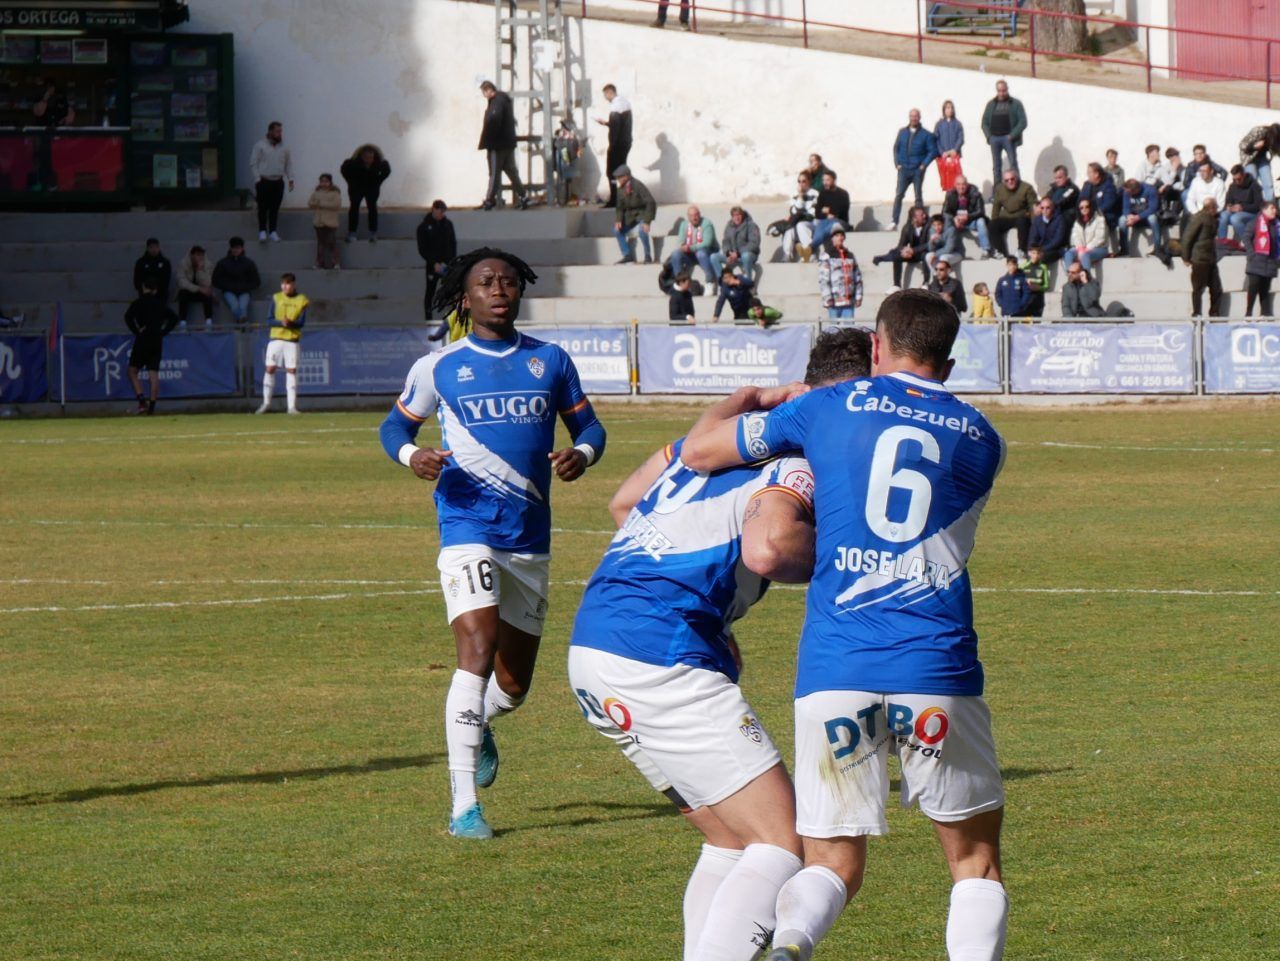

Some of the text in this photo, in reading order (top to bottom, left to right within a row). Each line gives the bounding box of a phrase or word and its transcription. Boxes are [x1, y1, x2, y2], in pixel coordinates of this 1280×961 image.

[18, 11, 79, 24] ORTEGA
[1049, 338, 1104, 348] COLLADO
[463, 396, 547, 420] YUGO
[846, 390, 981, 440] Cabezuelo
[865, 425, 940, 543] 6
[462, 560, 494, 594] 16
[824, 702, 949, 760] DTBO
